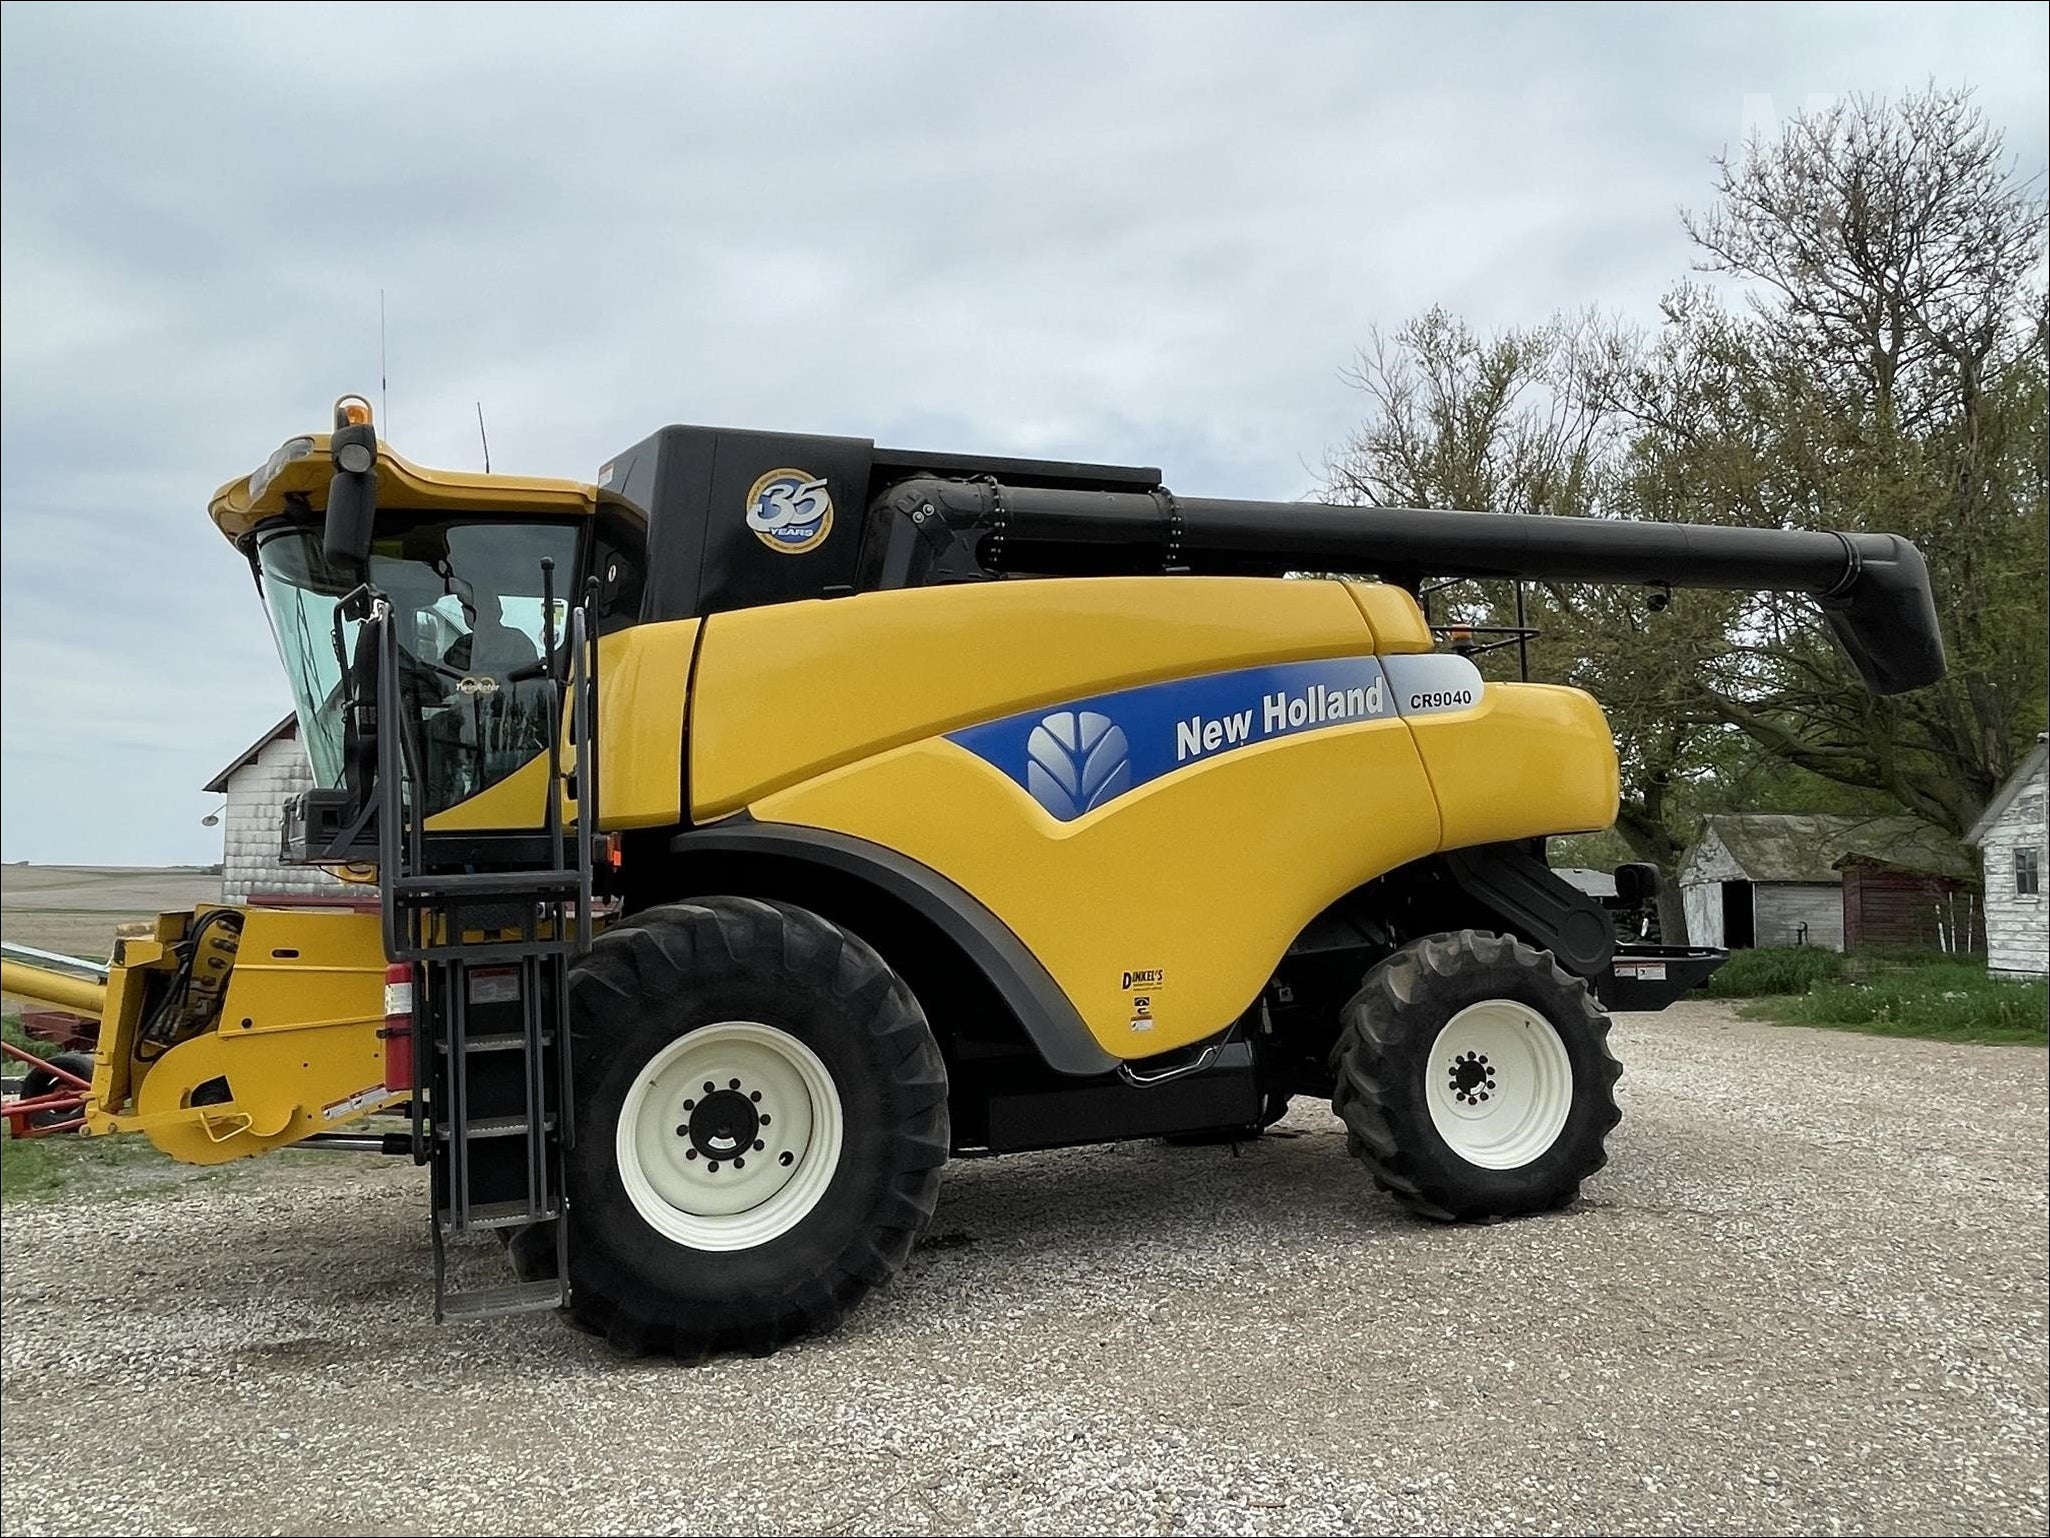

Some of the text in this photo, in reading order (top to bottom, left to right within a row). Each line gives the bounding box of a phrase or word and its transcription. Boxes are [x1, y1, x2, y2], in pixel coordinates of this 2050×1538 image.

[746, 478, 828, 532] 35
[769, 527, 814, 537] YEARS
[1410, 690, 1472, 709] CR9040
[1176, 677, 1383, 760] New Holland
